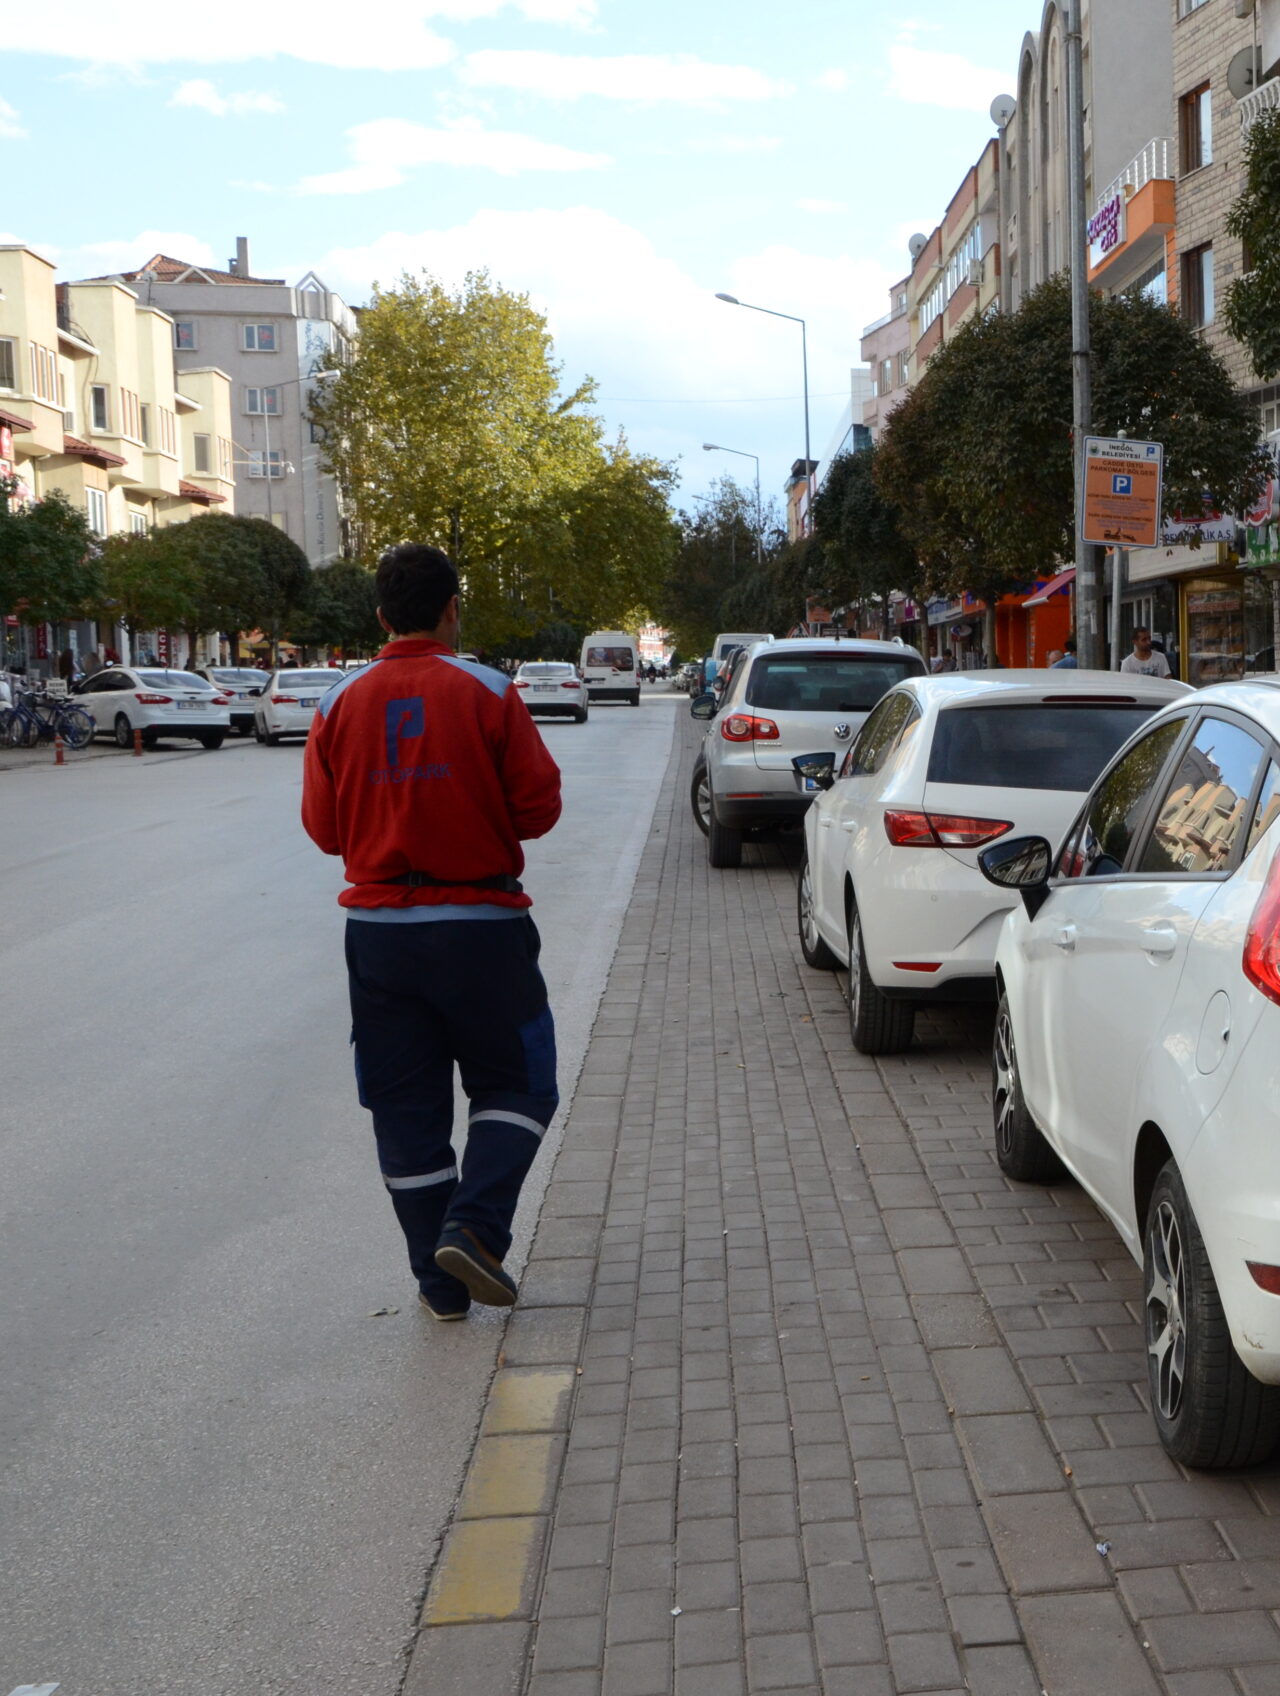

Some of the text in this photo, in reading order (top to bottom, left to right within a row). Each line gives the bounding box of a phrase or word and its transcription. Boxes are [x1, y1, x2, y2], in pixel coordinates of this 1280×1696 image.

[1109, 442, 1134, 452] İNEGÖL
[1101, 450, 1141, 460] BELEDİYESİ
[369, 762, 452, 785] OTOPARK
